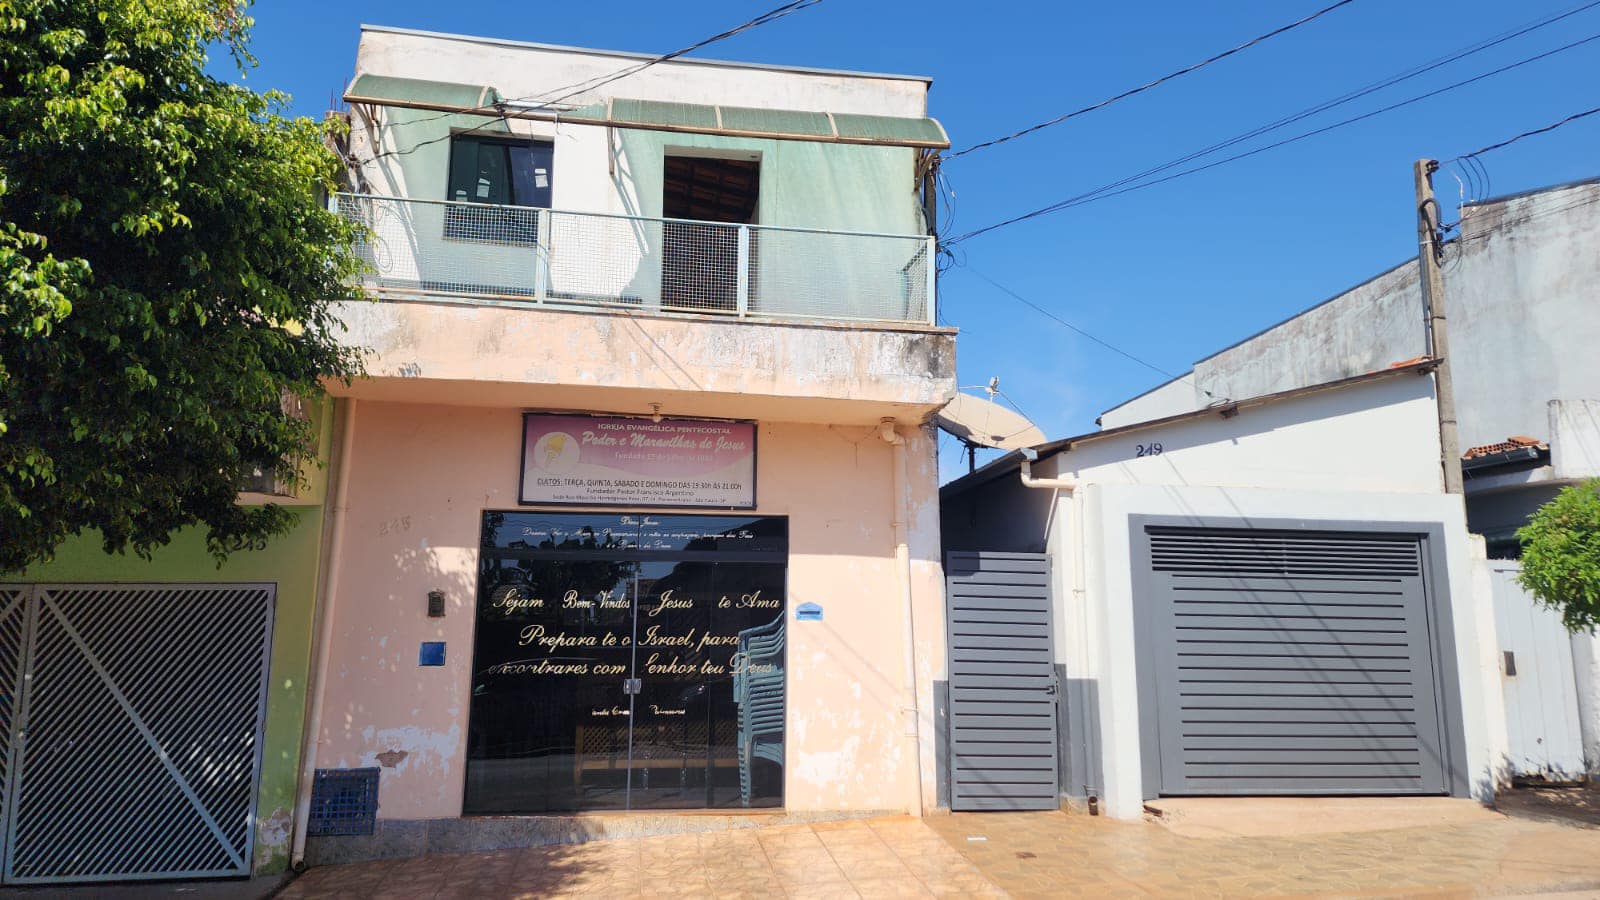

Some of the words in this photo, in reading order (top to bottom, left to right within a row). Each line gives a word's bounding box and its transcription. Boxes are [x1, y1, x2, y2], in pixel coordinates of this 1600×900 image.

[597, 423, 625, 431] IGREJA
[626, 423, 676, 432] EVANGÉLICA
[677, 426, 732, 434] PENTECOSTAL
[582, 430, 617, 446] Poder
[618, 437, 626, 446] e
[630, 432, 697, 449] Maravilhas
[699, 437, 713, 449] de
[714, 436, 747, 454] Jesus
[1135, 442, 1164, 458] 249
[537, 478, 563, 487] CULTOS:
[587, 479, 613, 488] QUINTA,
[645, 481, 677, 489] DOMINGO
[493, 588, 545, 616] Sejam
[649, 589, 694, 617] Jesus
[718, 595, 731, 609] te
[736, 590, 781, 609] Ama
[518, 624, 598, 653] Prepara
[602, 631, 617, 647] te
[621, 637, 632, 647] o
[638, 625, 695, 648] Israel,
[695, 631, 741, 653] para
[592, 664, 627, 675] com
[700, 659, 726, 674] teu
[729, 652, 772, 677] Deus
